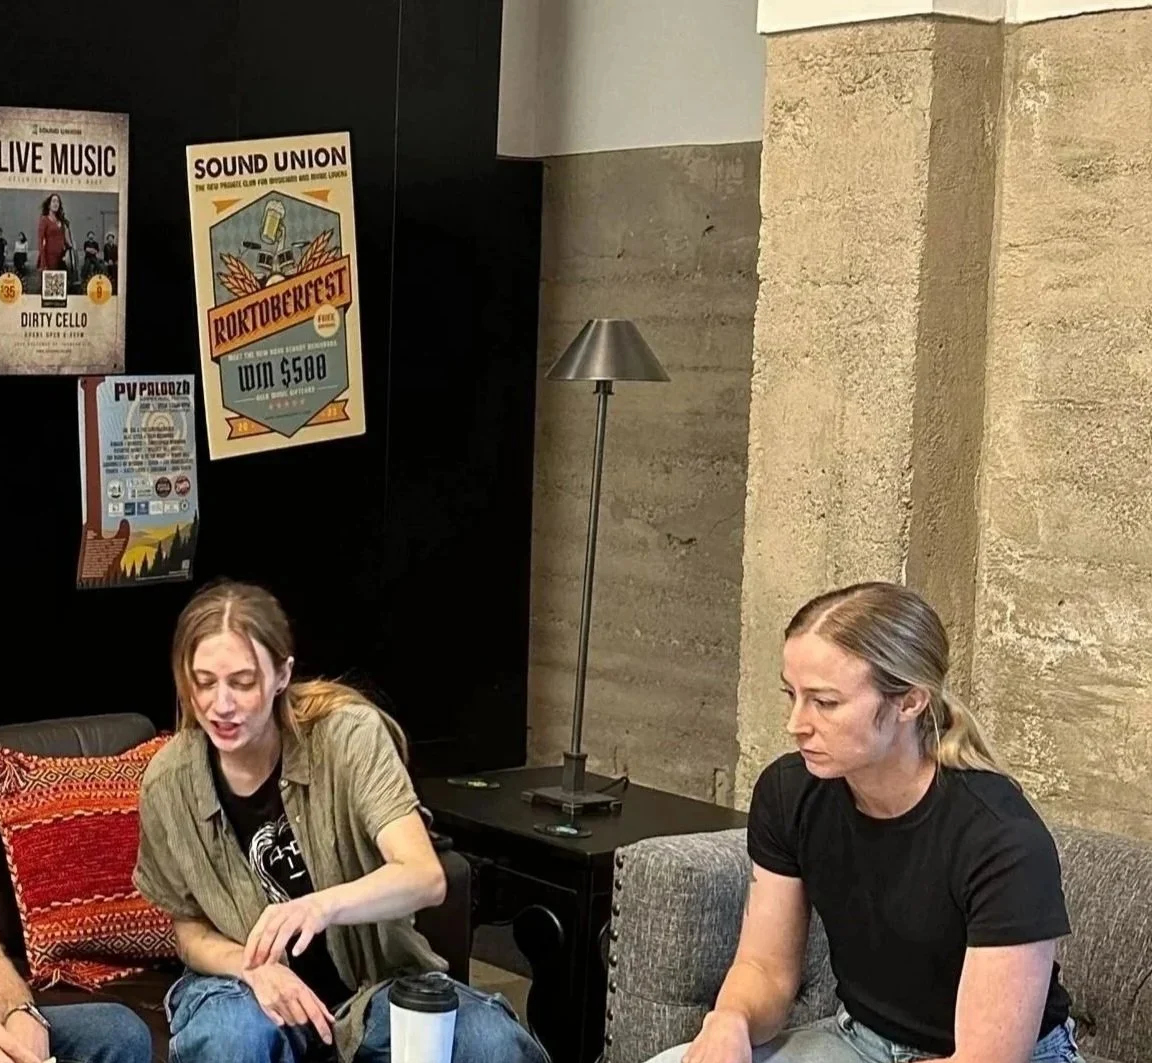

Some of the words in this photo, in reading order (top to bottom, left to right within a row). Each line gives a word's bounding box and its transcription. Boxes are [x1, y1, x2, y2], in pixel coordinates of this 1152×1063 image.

[51, 143, 116, 177] MUSIC
[194, 153, 268, 179] SOUND
[274, 146, 347, 172] UNION
[1, 285, 15, 298] $35
[214, 266, 347, 347] ROKTOBERFEST
[21, 312, 52, 328] DIRTY
[55, 312, 87, 328] CELLO
[238, 361, 275, 392] WIN
[280, 353, 327, 388] $500
